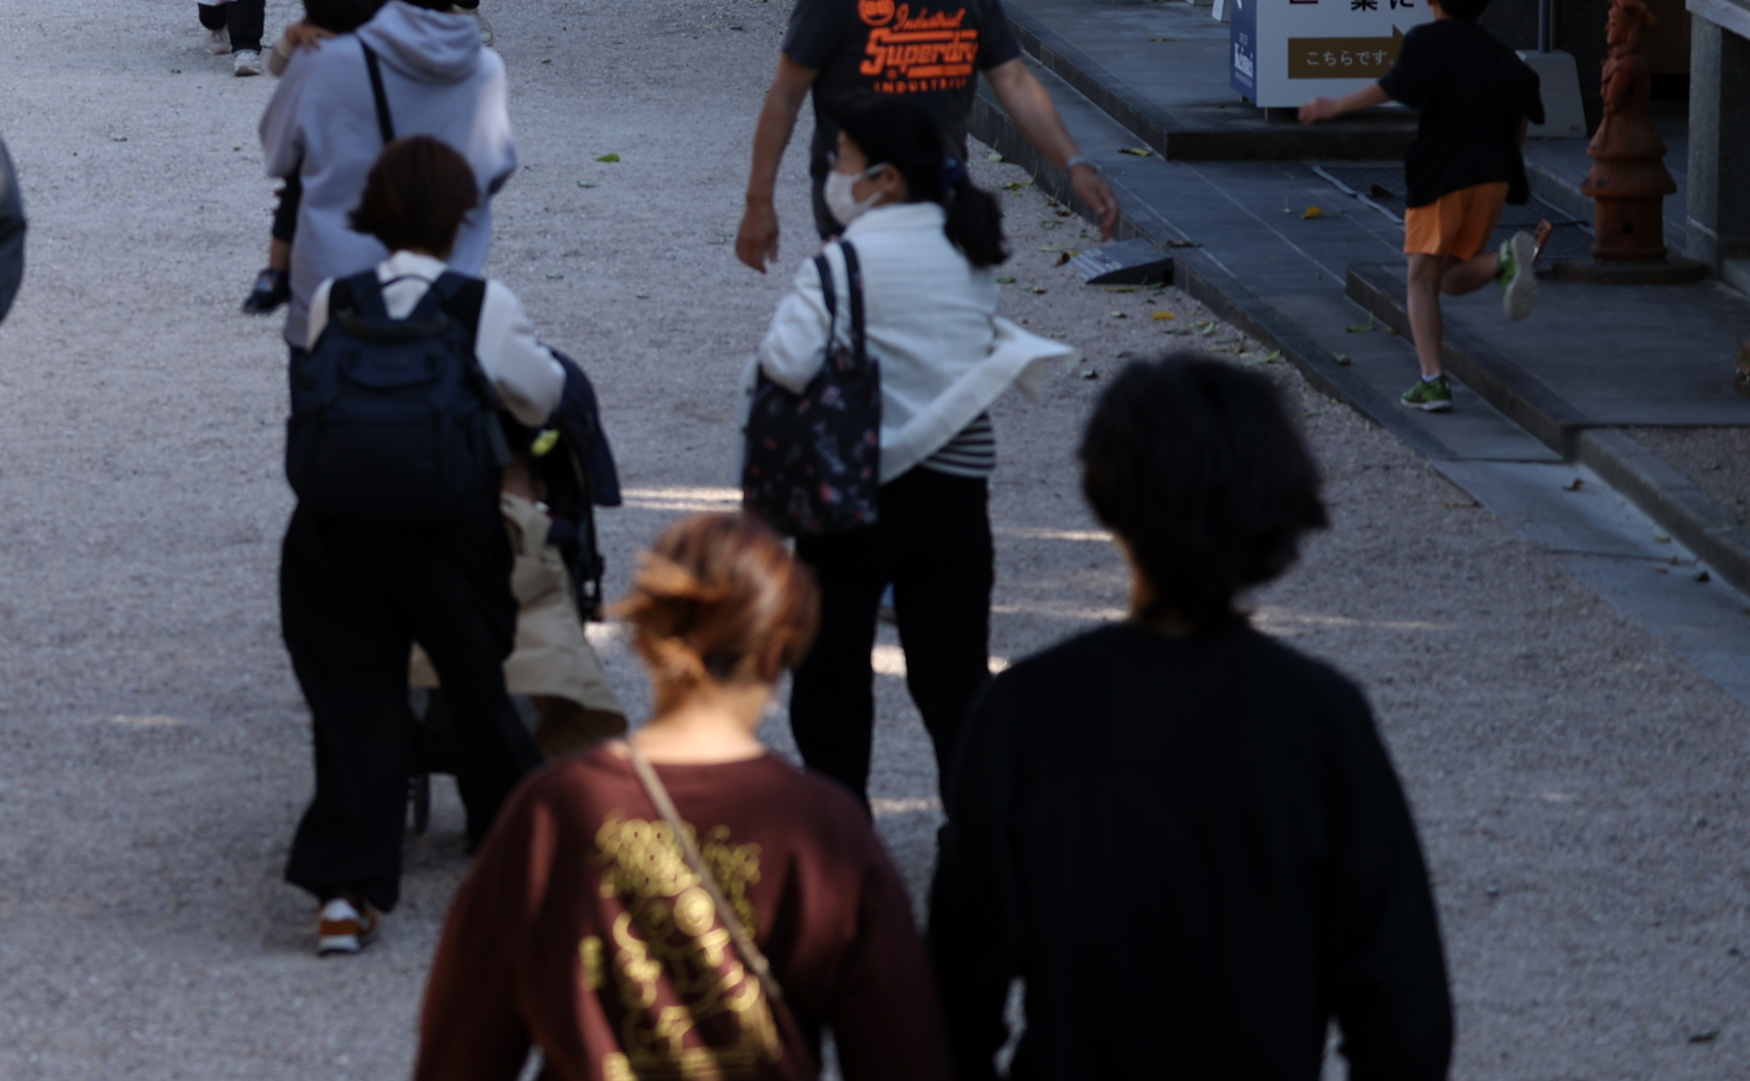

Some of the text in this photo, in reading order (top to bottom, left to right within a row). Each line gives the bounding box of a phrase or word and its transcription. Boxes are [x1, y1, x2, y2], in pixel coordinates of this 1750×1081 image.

[860, 27, 979, 74] Superdry
[1306, 50, 1396, 67] こちらです。
